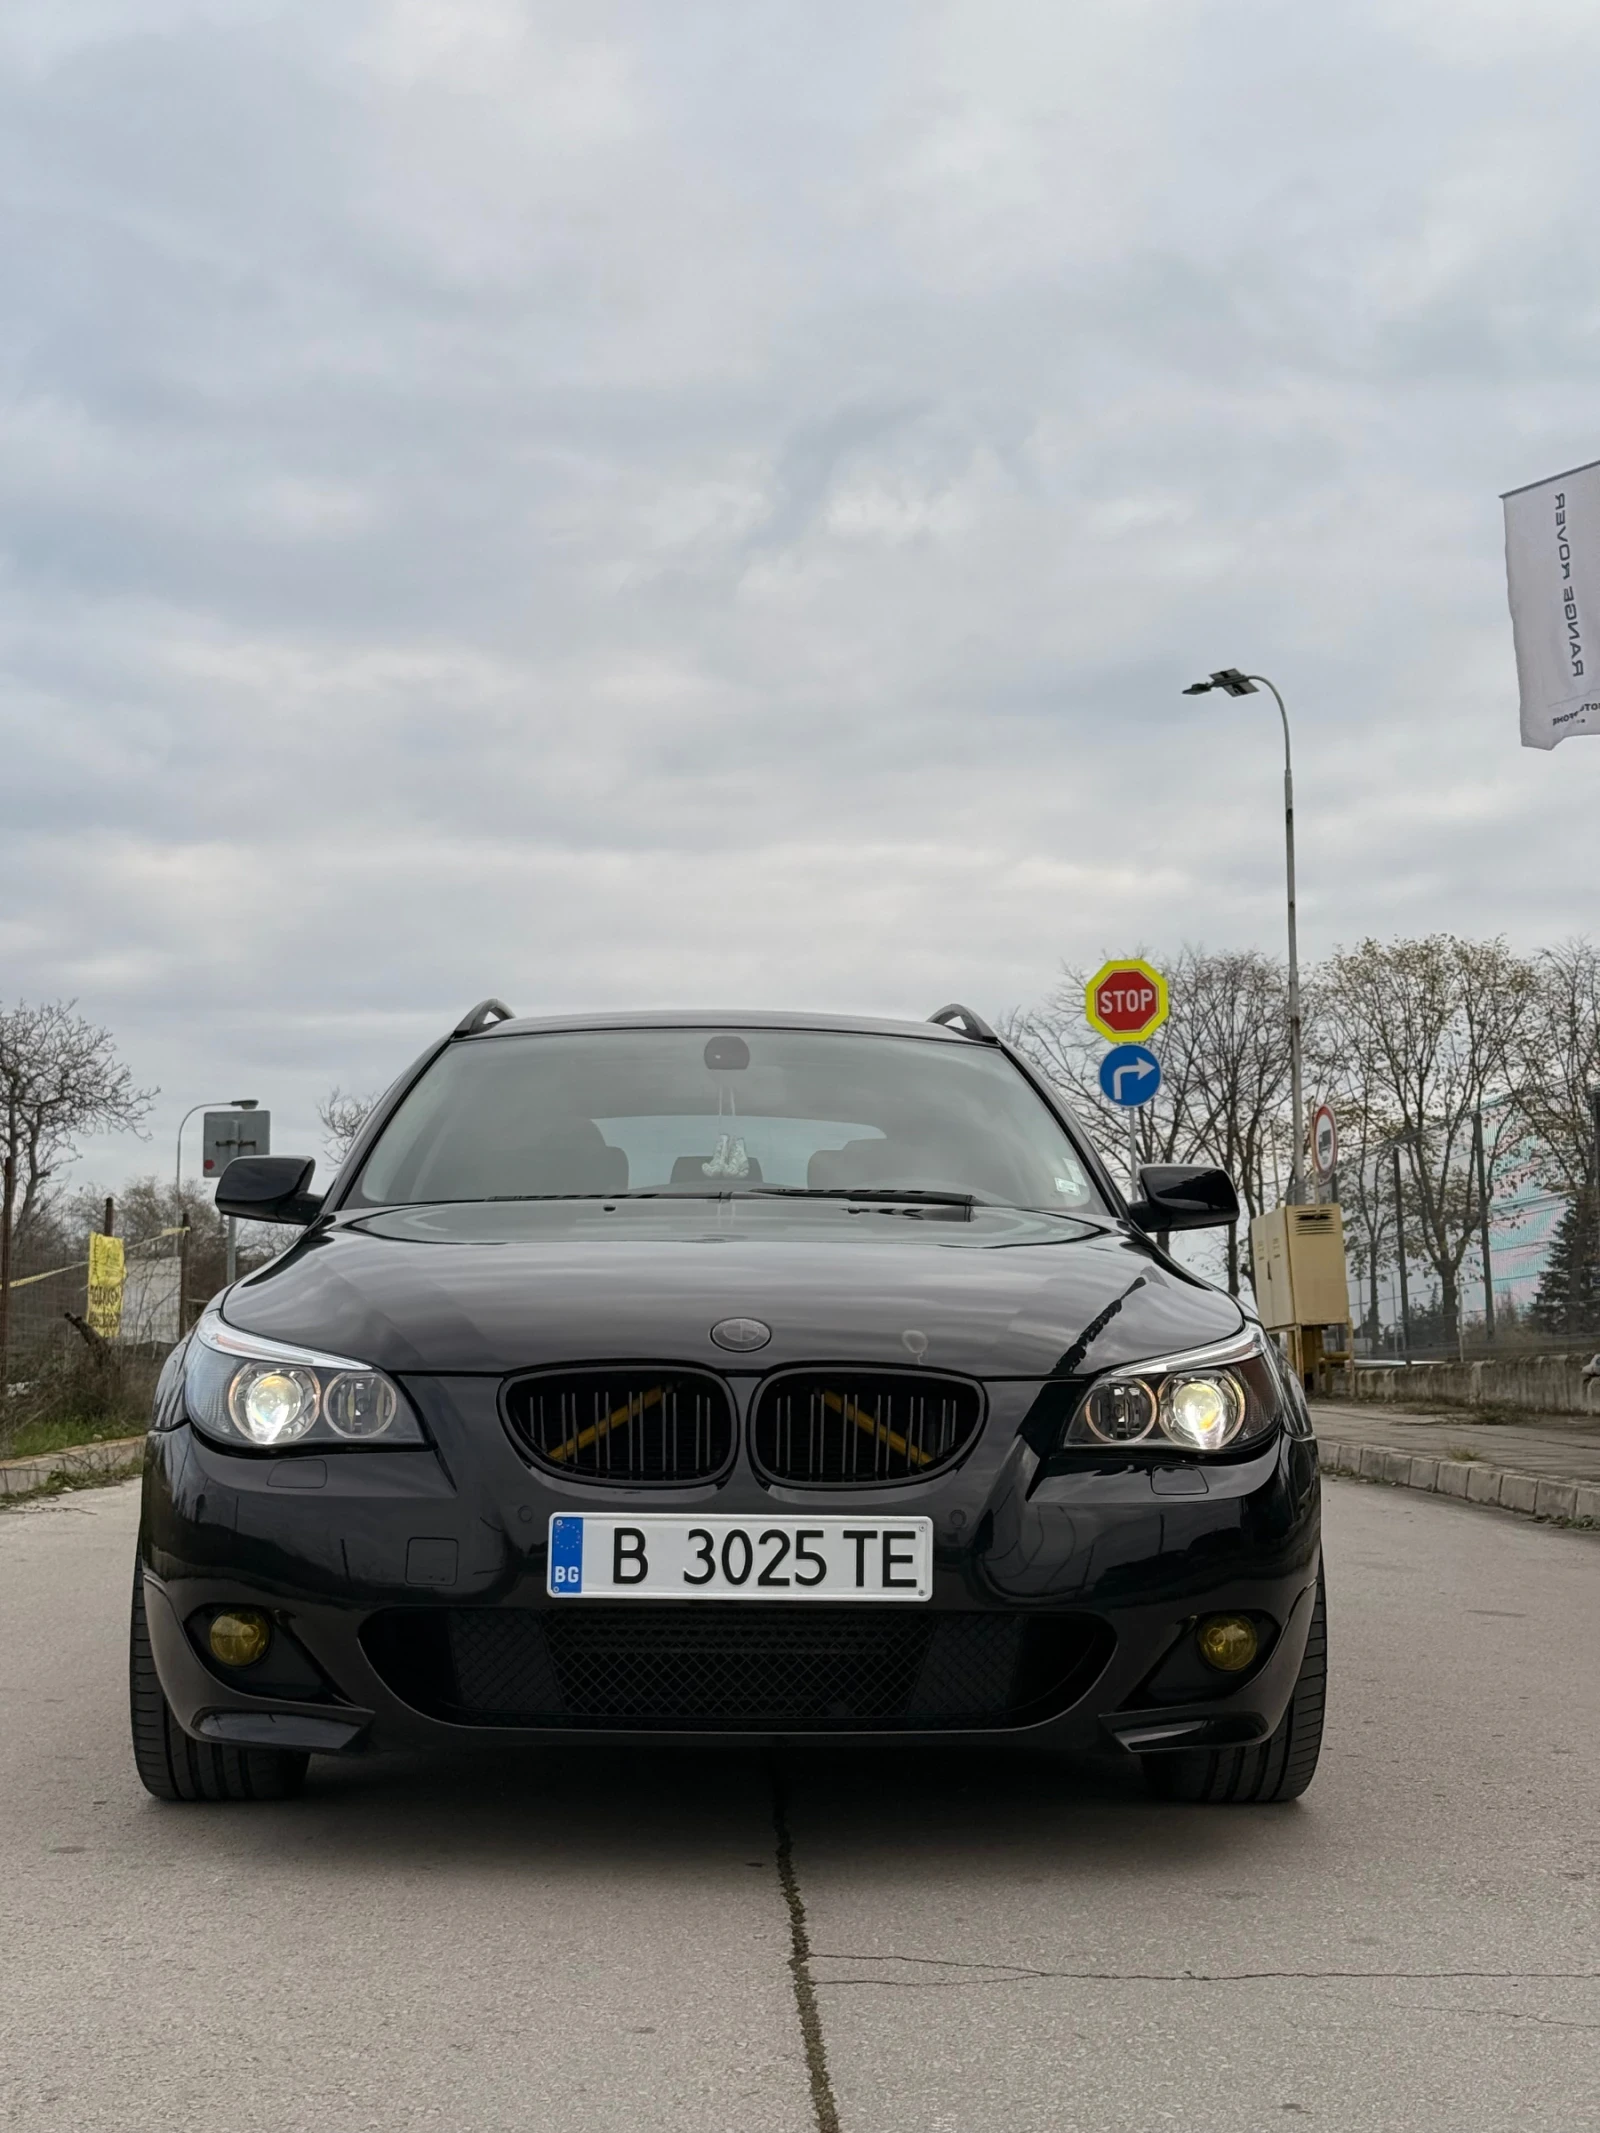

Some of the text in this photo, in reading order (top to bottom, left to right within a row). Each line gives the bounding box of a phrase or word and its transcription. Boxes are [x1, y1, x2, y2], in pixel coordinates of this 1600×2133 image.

[1100, 988, 1153, 1014] STOP
[612, 1526, 918, 1588] B 3025 TE
[554, 1565, 580, 1584] BG
